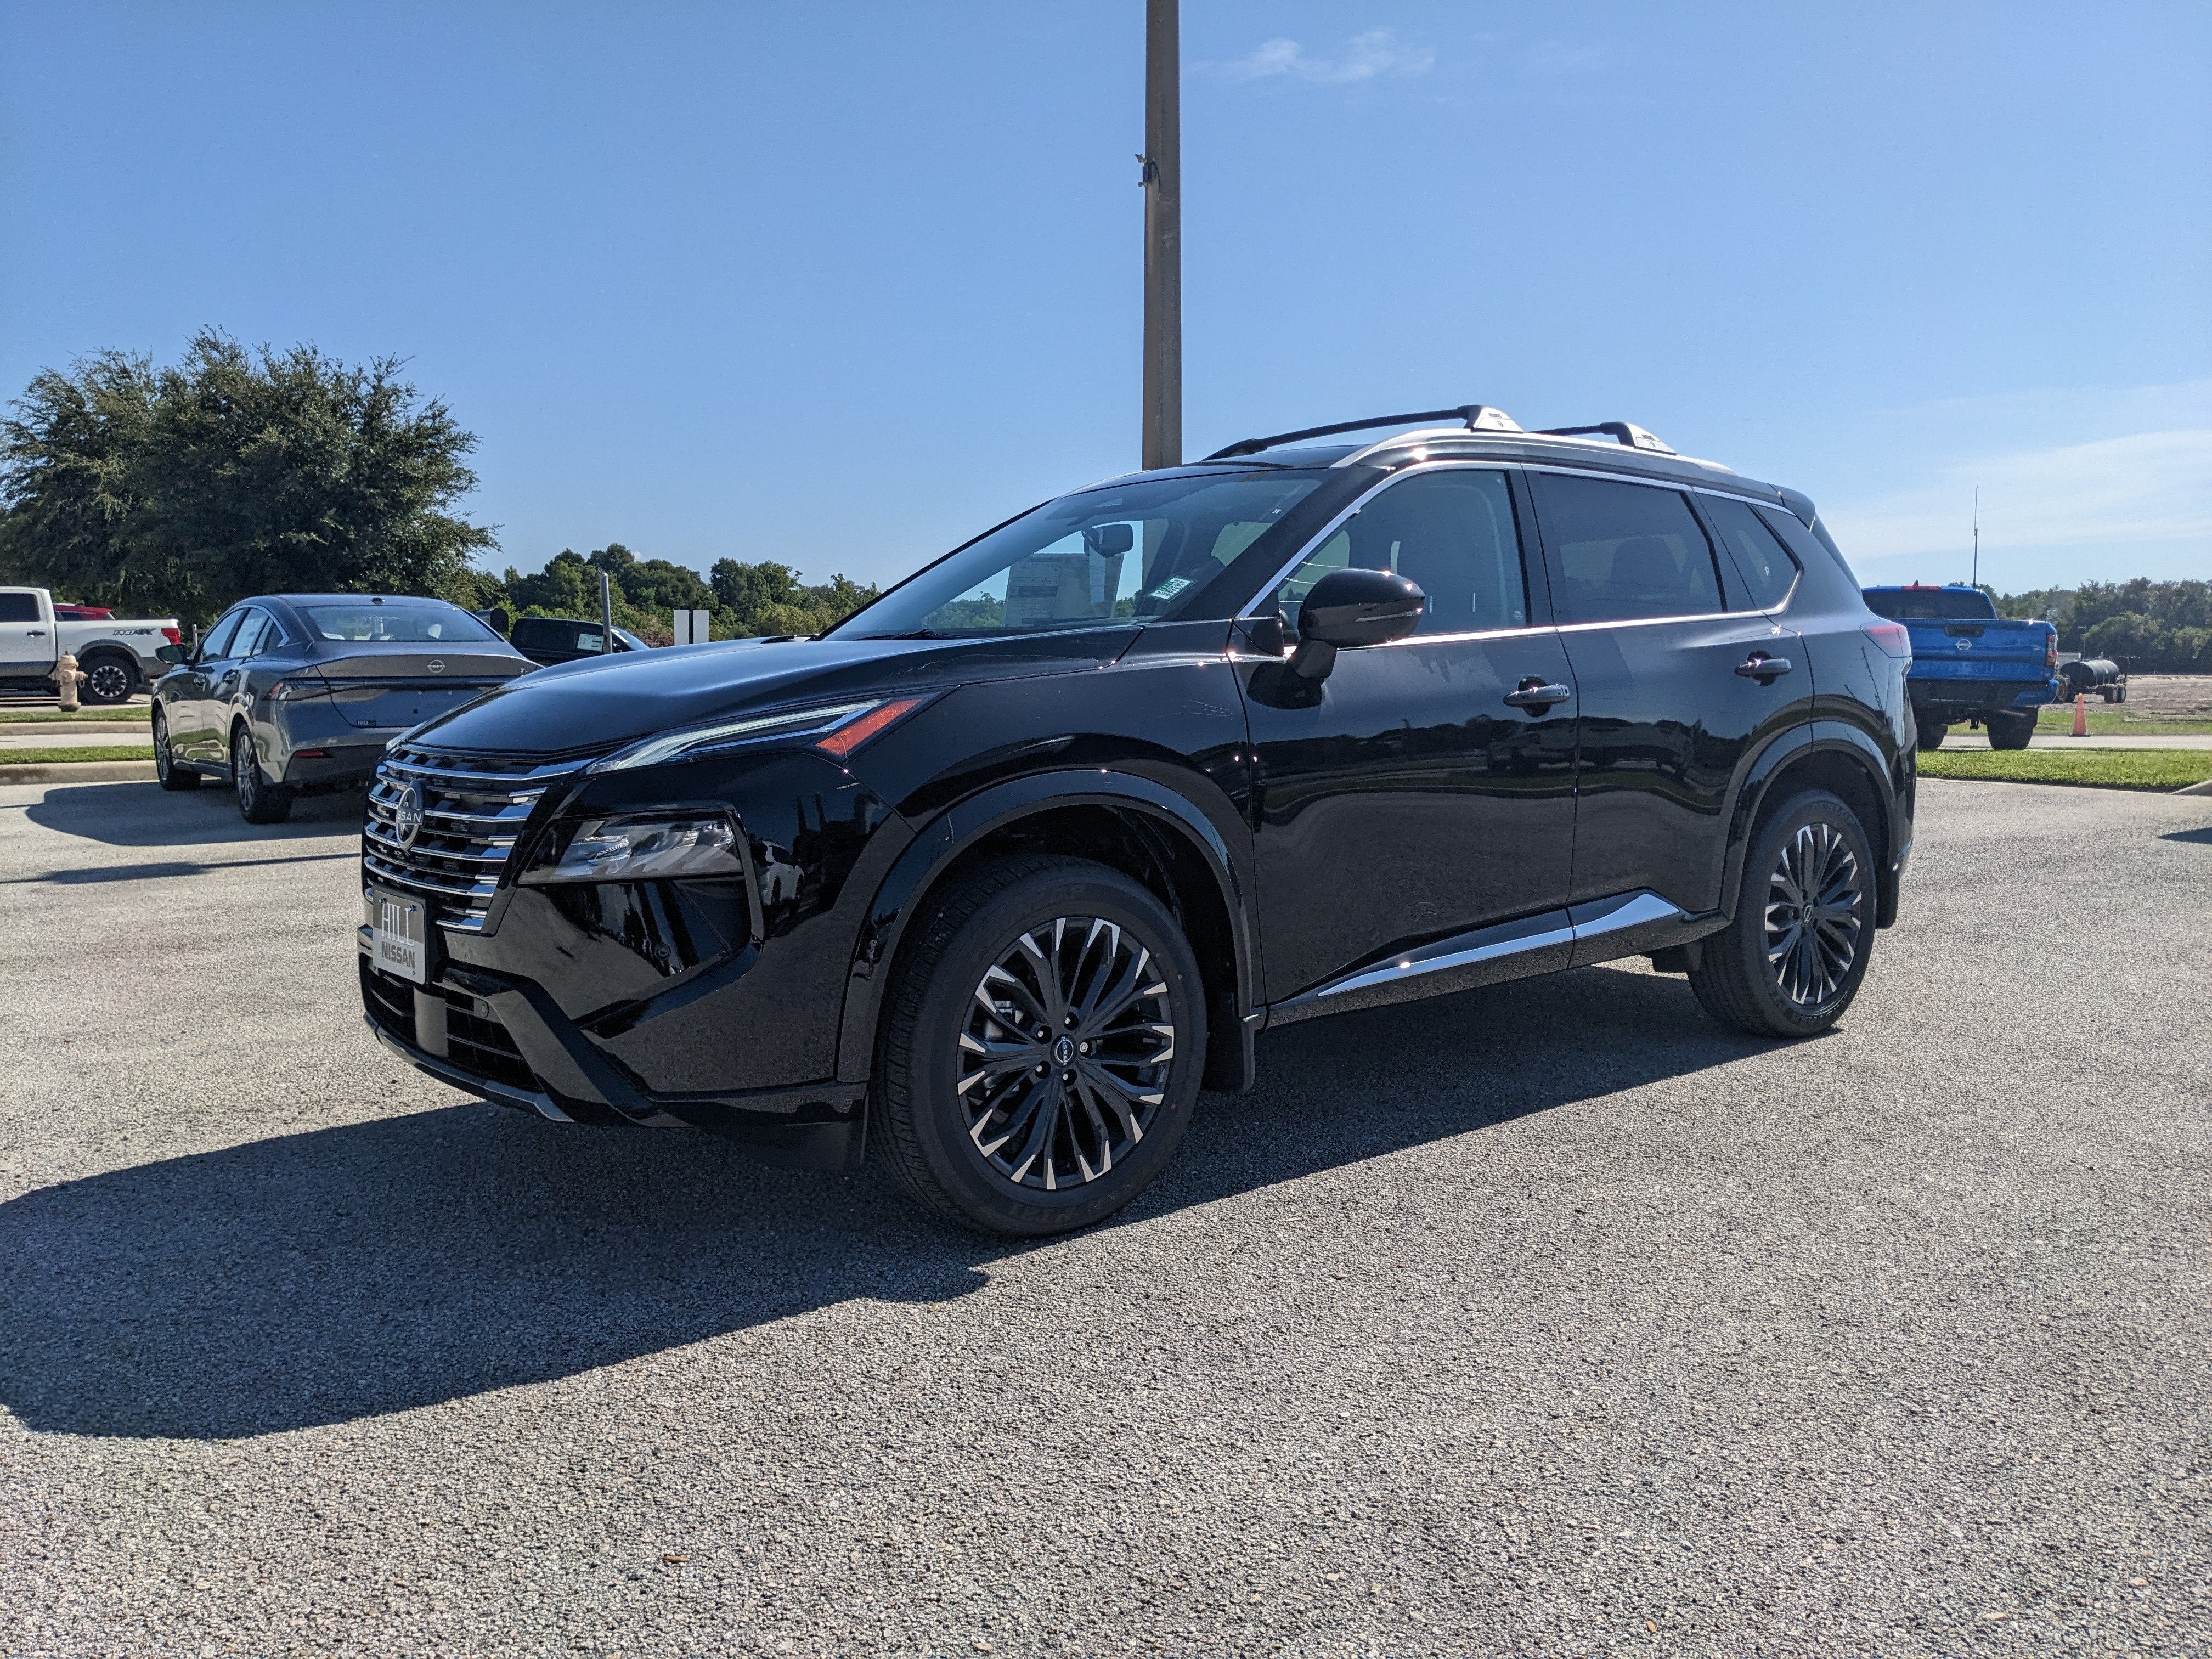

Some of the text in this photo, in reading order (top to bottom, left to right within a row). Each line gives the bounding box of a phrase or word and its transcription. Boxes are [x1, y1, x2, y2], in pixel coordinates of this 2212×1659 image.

[397, 811, 422, 823] SSAN
[381, 902, 415, 947] HILL
[381, 941, 415, 969] NISSAN
